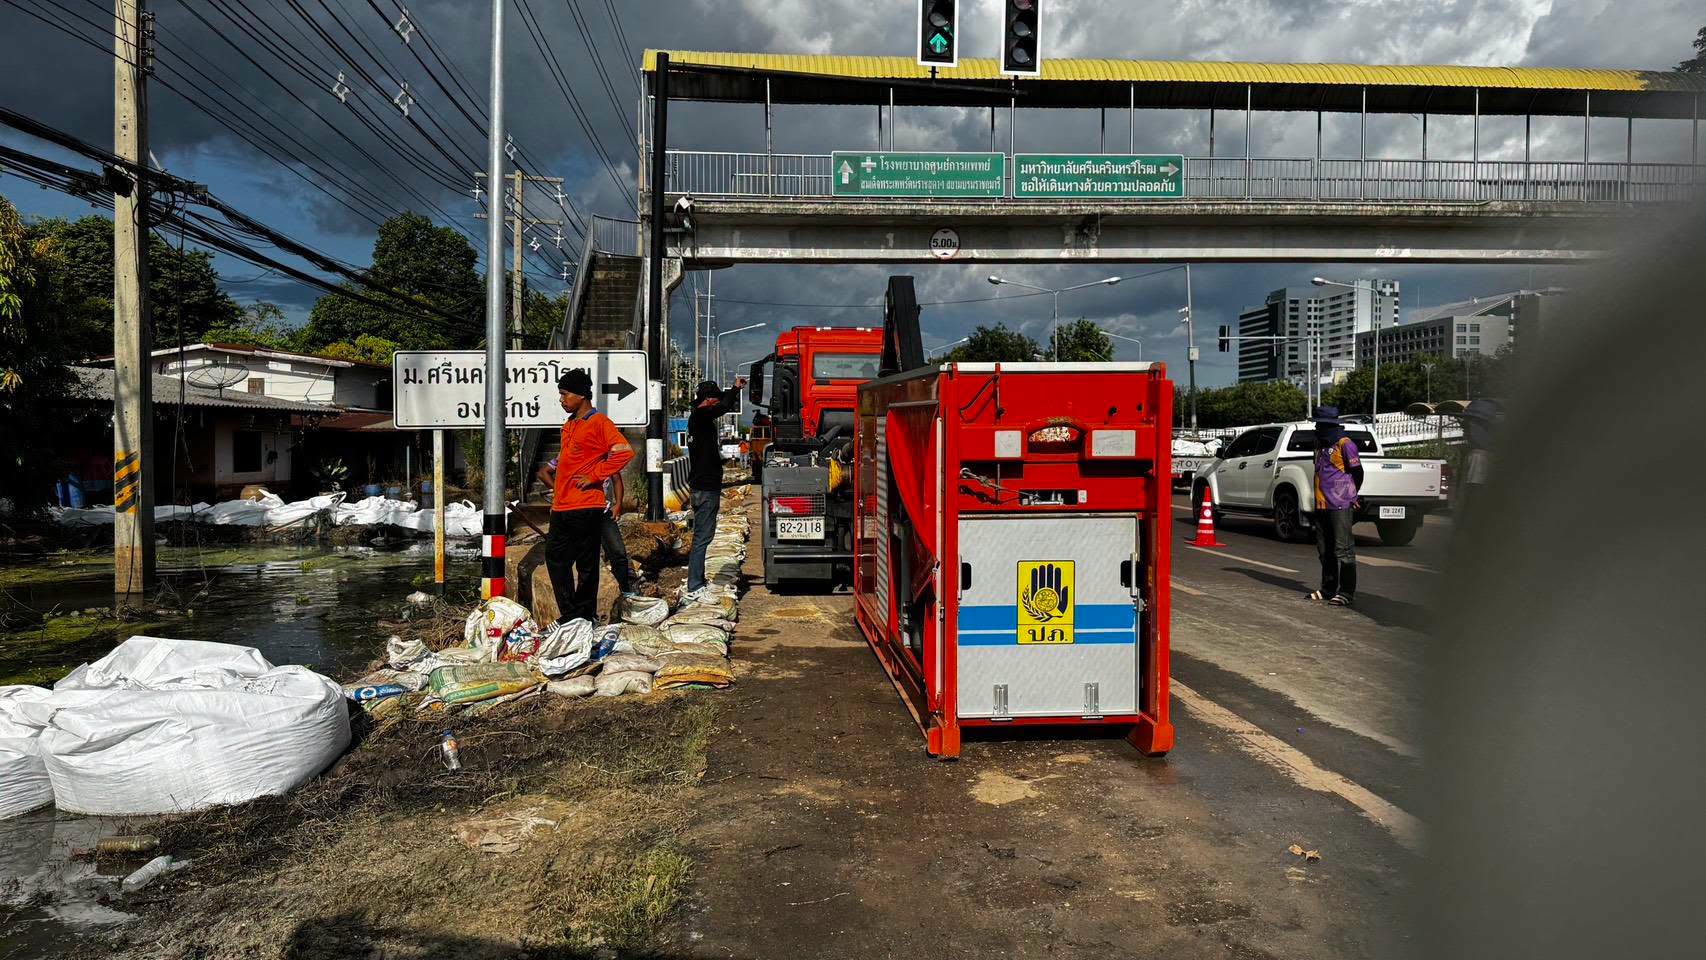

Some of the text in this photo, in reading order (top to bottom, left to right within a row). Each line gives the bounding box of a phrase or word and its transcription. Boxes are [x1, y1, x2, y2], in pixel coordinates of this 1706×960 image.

[880, 156, 991, 175] โรงพยาบาลศูนย์การแพทย์
[1020, 160, 1157, 175] มหาวิทยาลัยศรีนครินทรวิโรฒ
[1021, 177, 1176, 193] ขอให้เดินทางด้วยความปลอดภัย
[403, 368, 423, 385] ม.
[780, 522, 822, 533] 82-2118
[1028, 626, 1068, 642] ปภ.
